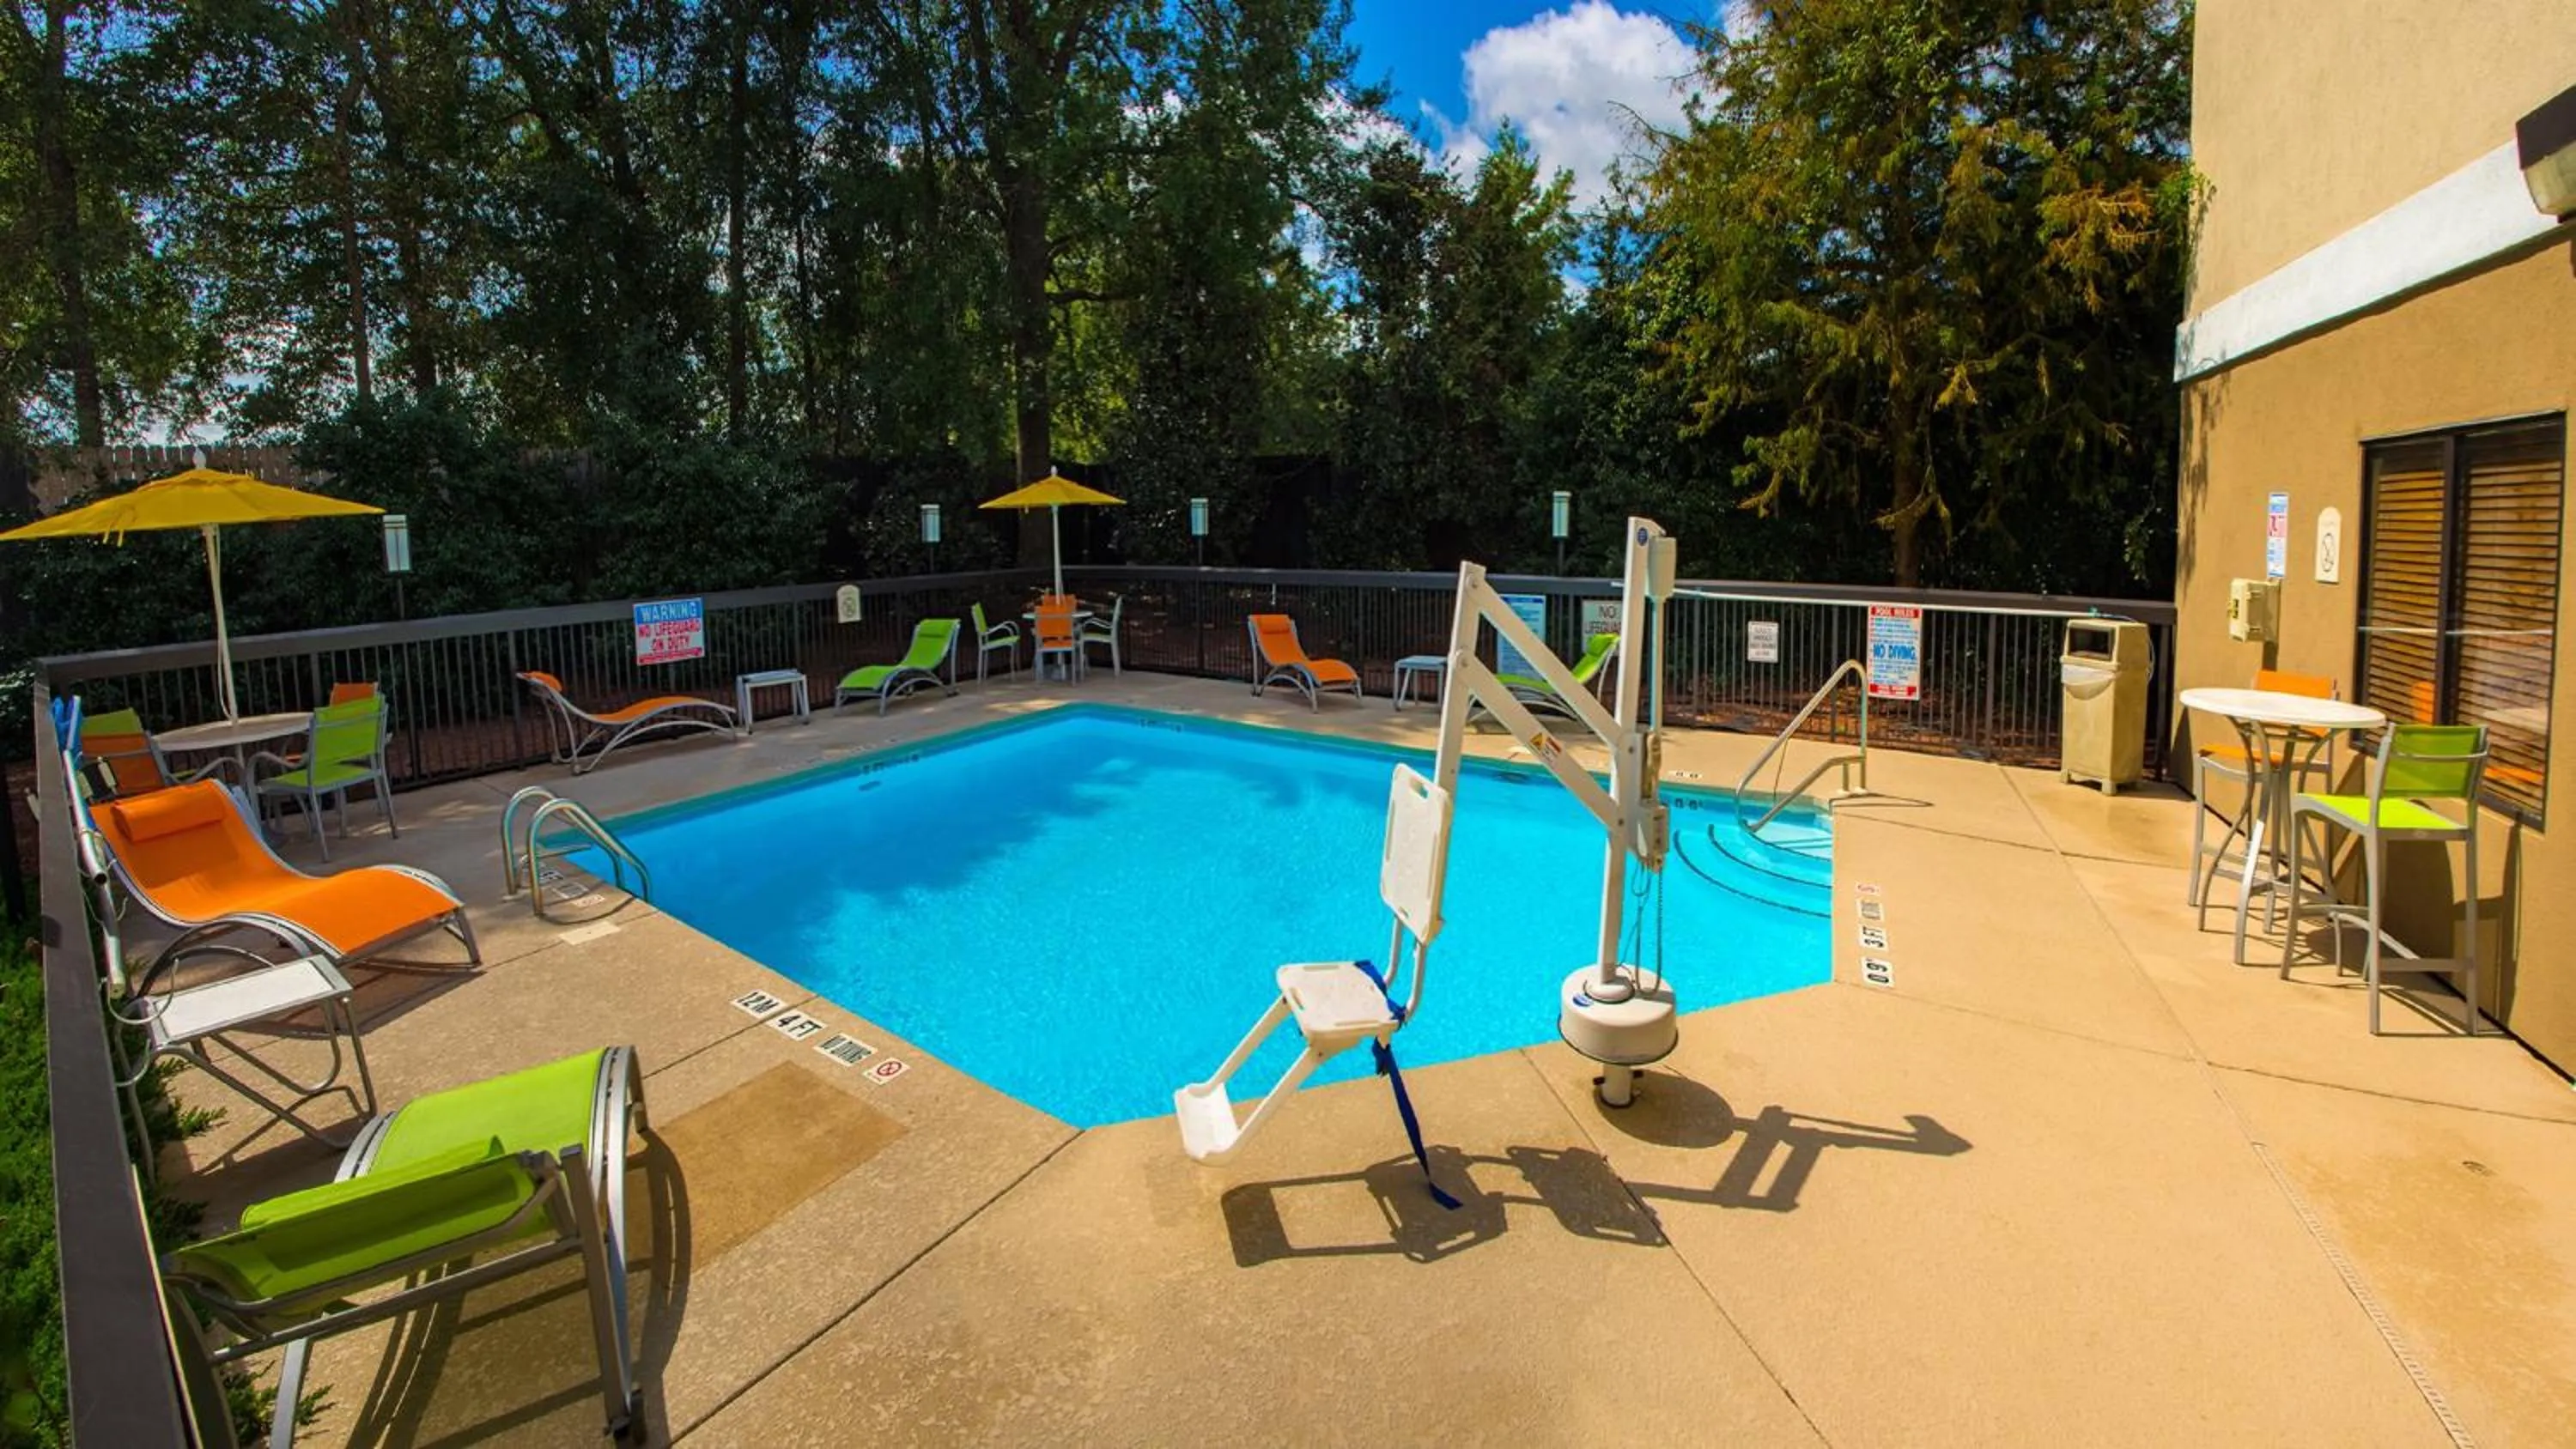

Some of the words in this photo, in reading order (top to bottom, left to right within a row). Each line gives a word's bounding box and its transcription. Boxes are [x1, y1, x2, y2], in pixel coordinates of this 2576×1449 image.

[640, 602, 696, 621] WARNING
[1598, 605, 1616, 619] NO
[1873, 644, 1886, 658] NO
[1888, 645, 1917, 660] DIVING
